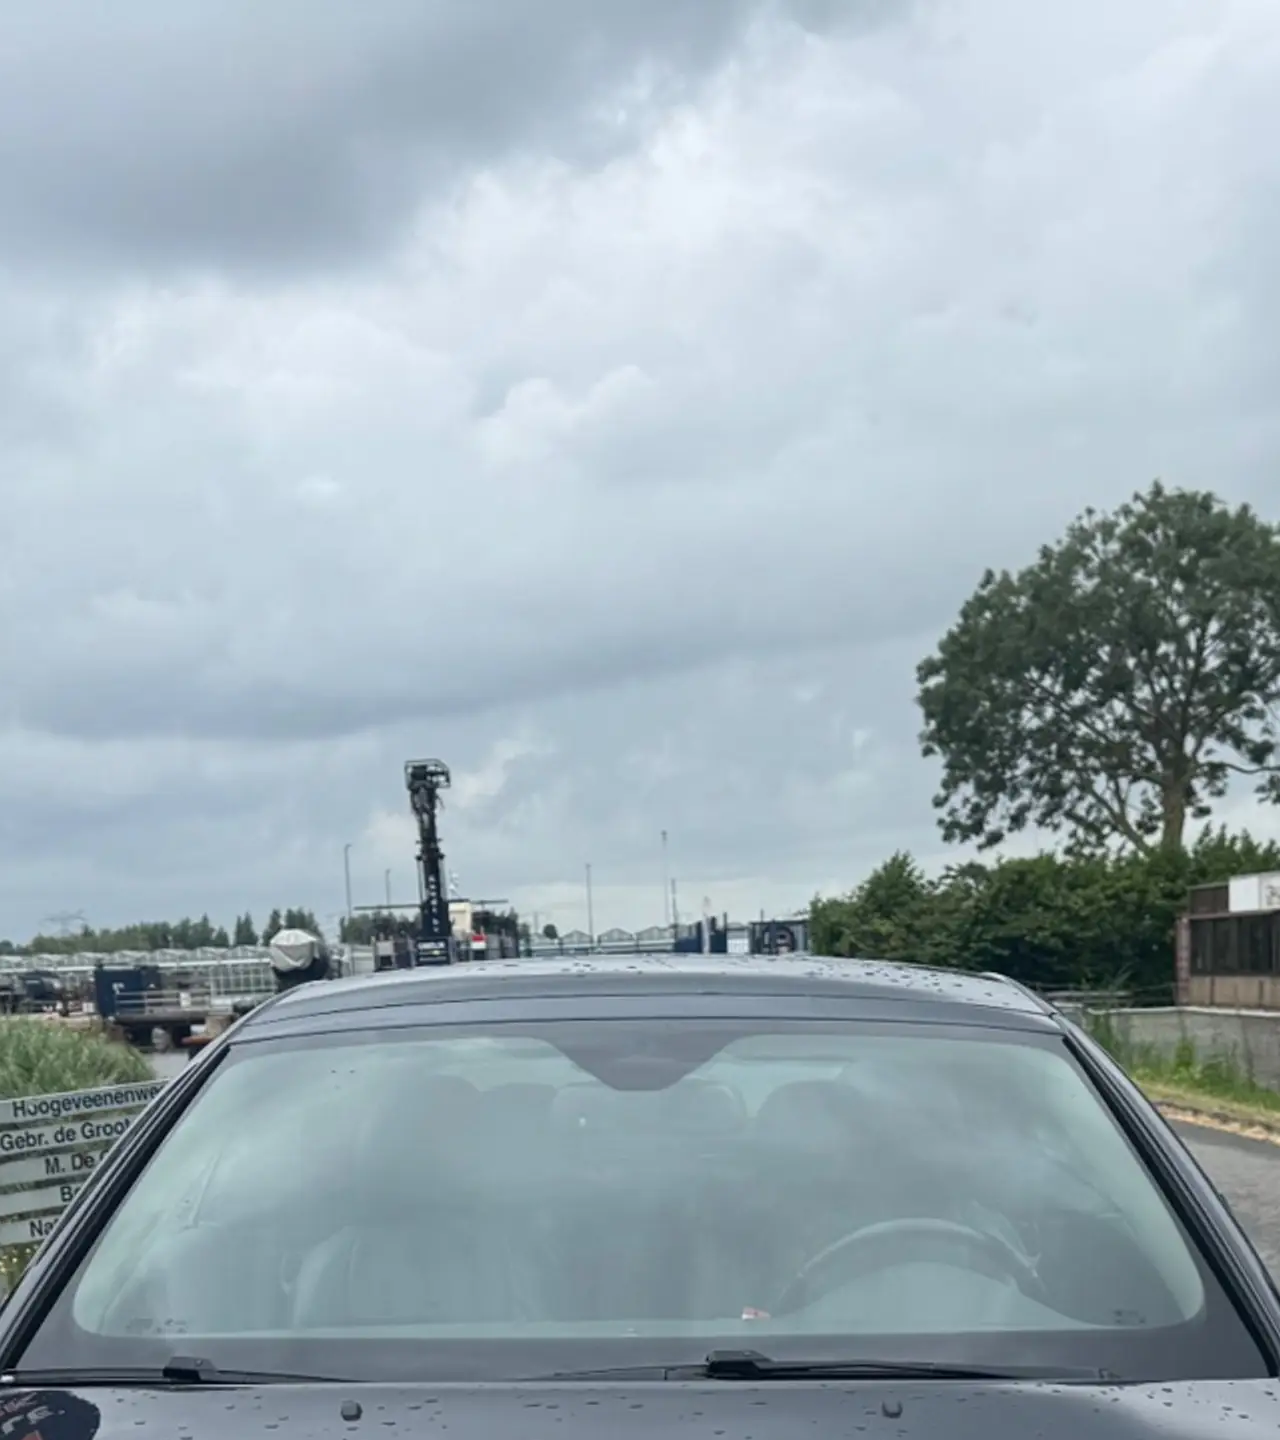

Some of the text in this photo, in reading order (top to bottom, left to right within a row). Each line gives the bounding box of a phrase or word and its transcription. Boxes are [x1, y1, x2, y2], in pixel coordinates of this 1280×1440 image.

[12, 1084, 165, 1119] Hoogeveenenwe
[0, 1131, 49, 1152] Gebr.
[53, 1126, 76, 1144] de
[44, 1156, 66, 1175] M.
[70, 1152, 95, 1171] De
